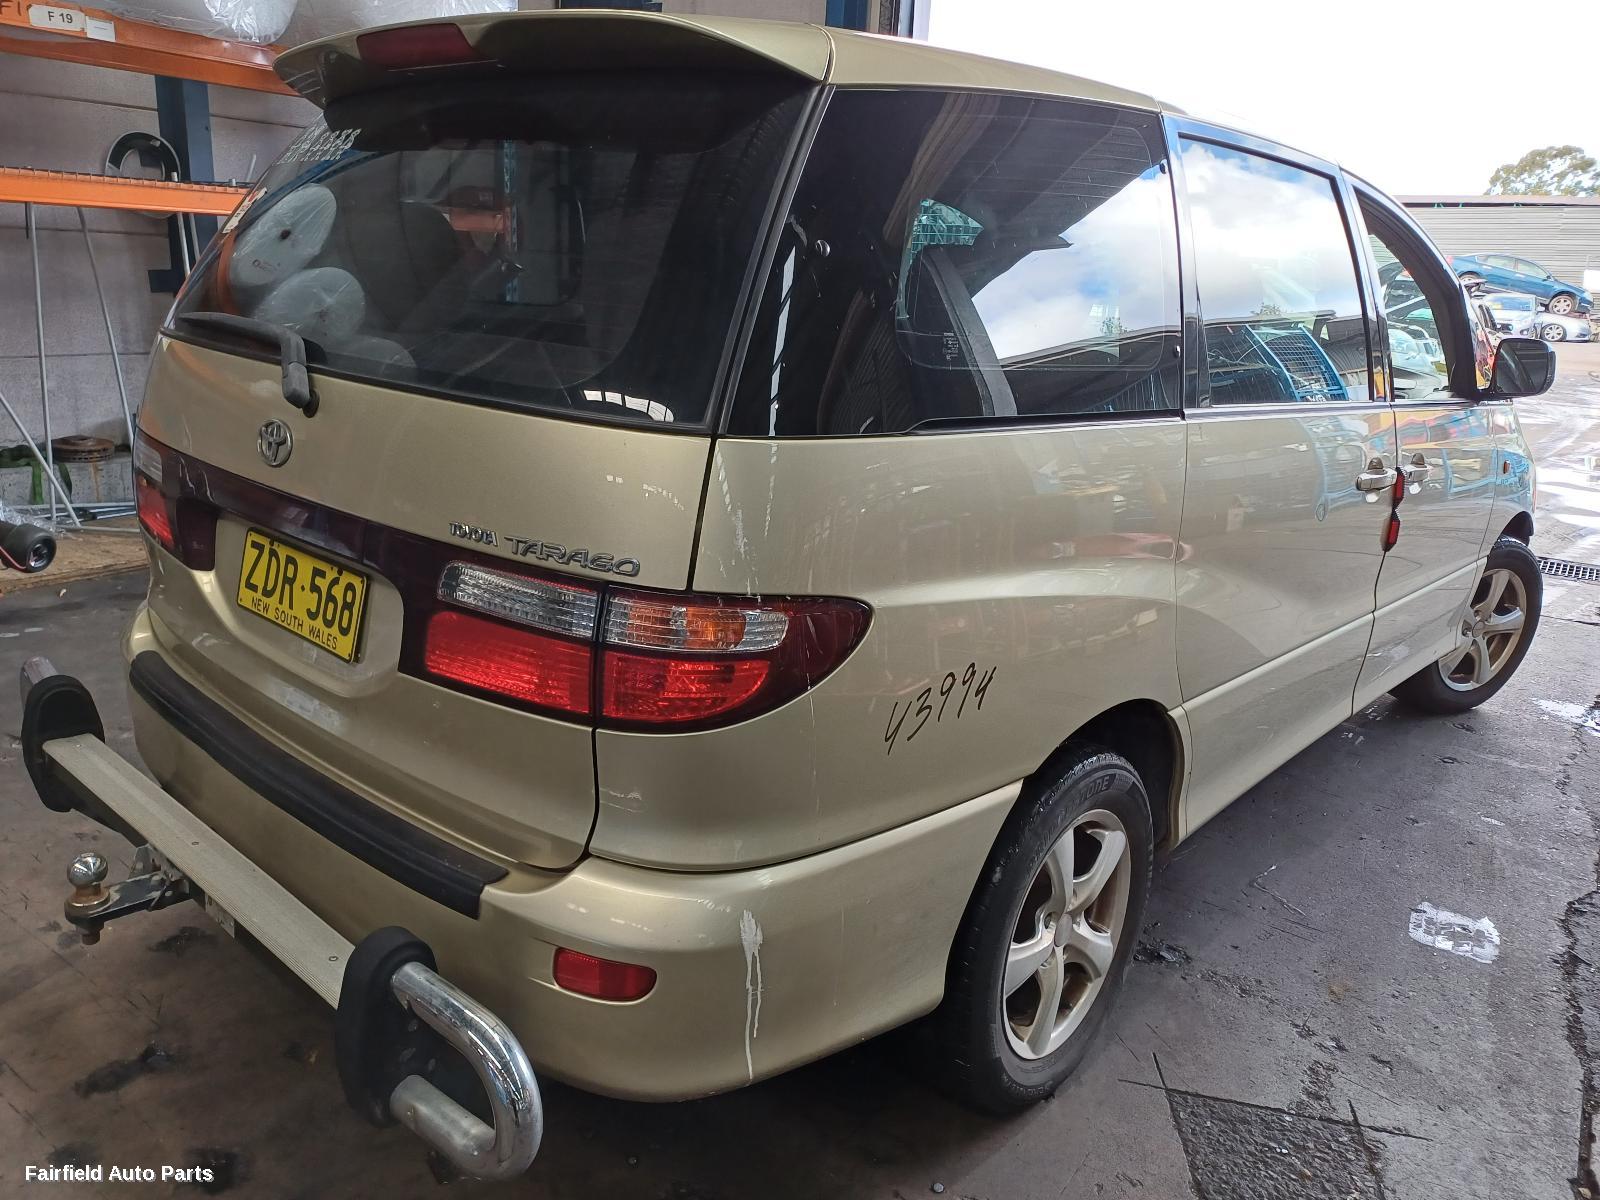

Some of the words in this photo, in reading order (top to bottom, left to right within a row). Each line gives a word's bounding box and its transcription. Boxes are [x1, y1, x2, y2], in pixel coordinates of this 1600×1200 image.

[47, 10, 55, 21] F
[59, 12, 73, 24] 19
[449, 521, 498, 547] TOYOTA
[504, 536, 641, 577] TARAGO
[251, 596, 271, 615] NEW
[274, 607, 304, 633] SOUTH
[308, 625, 338, 650] WALES
